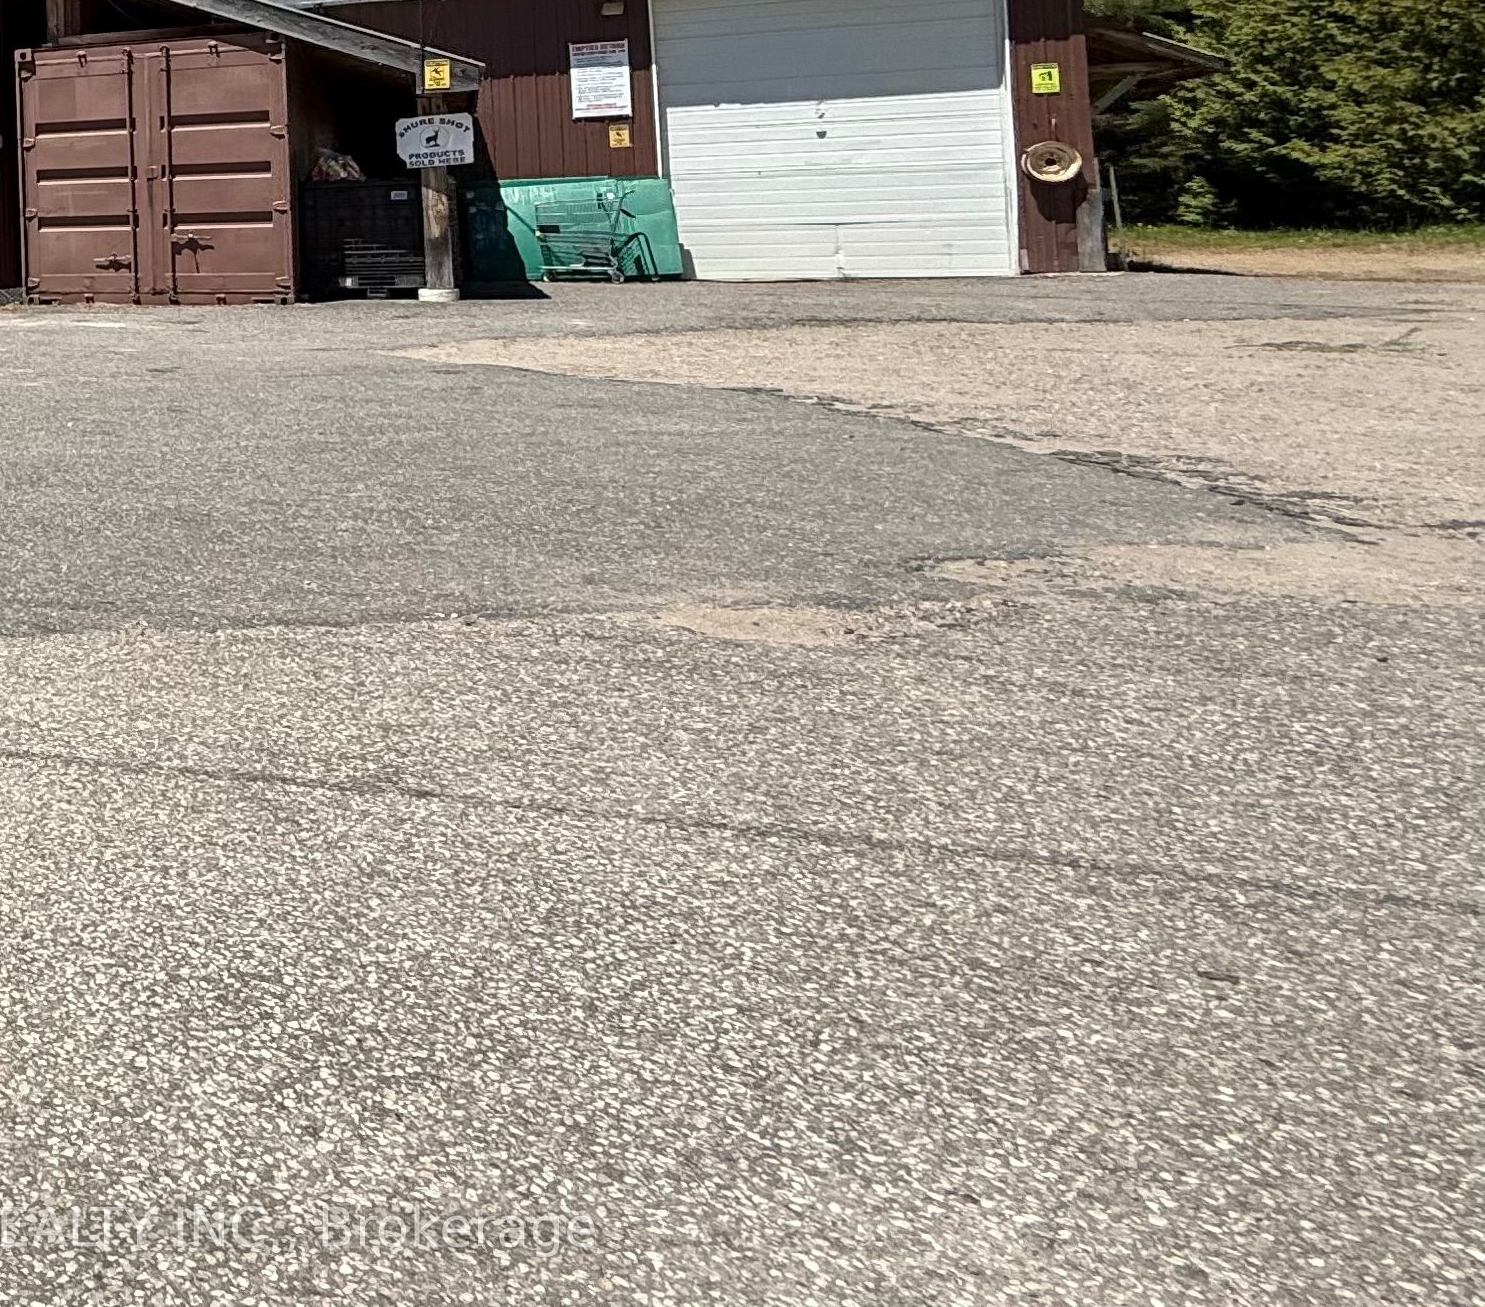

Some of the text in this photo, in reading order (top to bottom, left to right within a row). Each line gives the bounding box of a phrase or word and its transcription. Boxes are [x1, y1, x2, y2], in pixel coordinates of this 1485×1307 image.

[439, 117, 471, 133] SHOT
[408, 149, 465, 160] PRODUCTS
[408, 156, 466, 167] SOLD HERE
